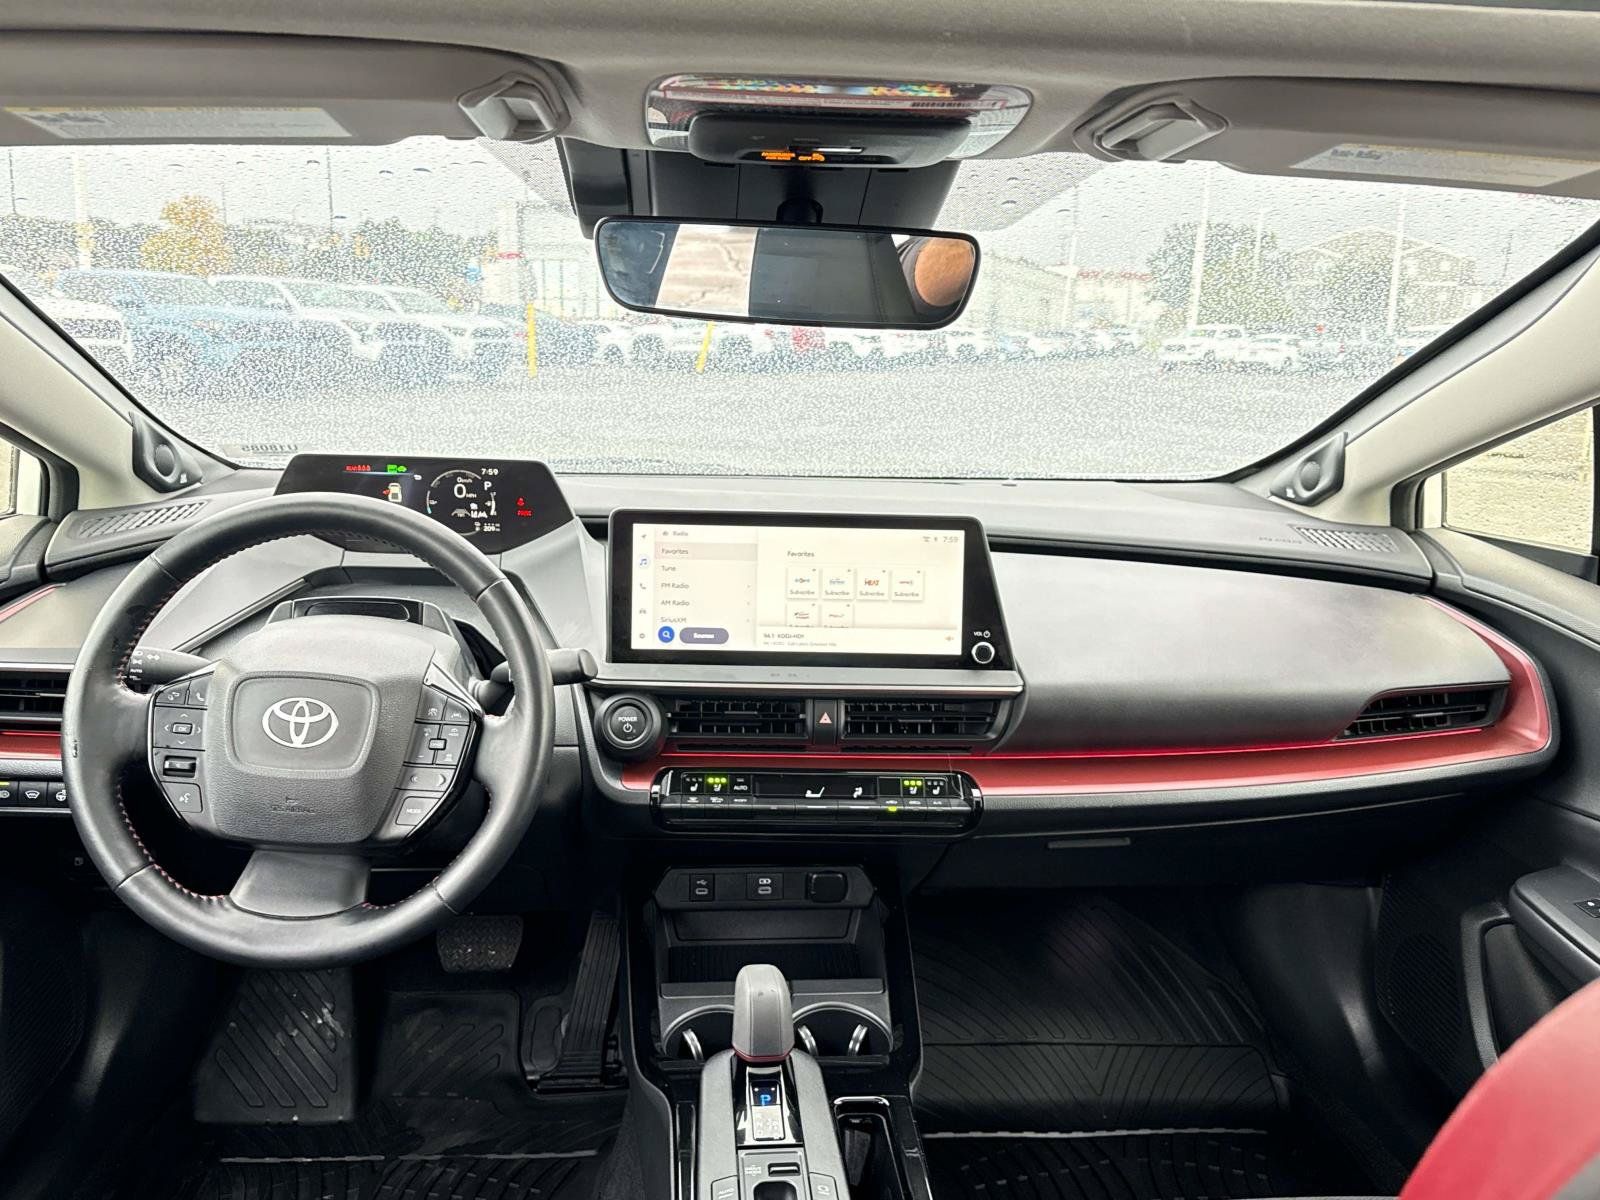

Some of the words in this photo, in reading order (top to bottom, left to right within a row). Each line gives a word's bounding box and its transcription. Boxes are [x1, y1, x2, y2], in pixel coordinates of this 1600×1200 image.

[483, 481, 493, 491] P
[942, 535, 959, 543] 7:59
[661, 547, 689, 555] Favorites
[787, 550, 815, 558] Favorites
[661, 564, 676, 572] Tune
[790, 588, 815, 596] Subscribe
[894, 590, 920, 598] Subscribe
[672, 599, 690, 607] Radio
[760, 1094, 771, 1105] P
